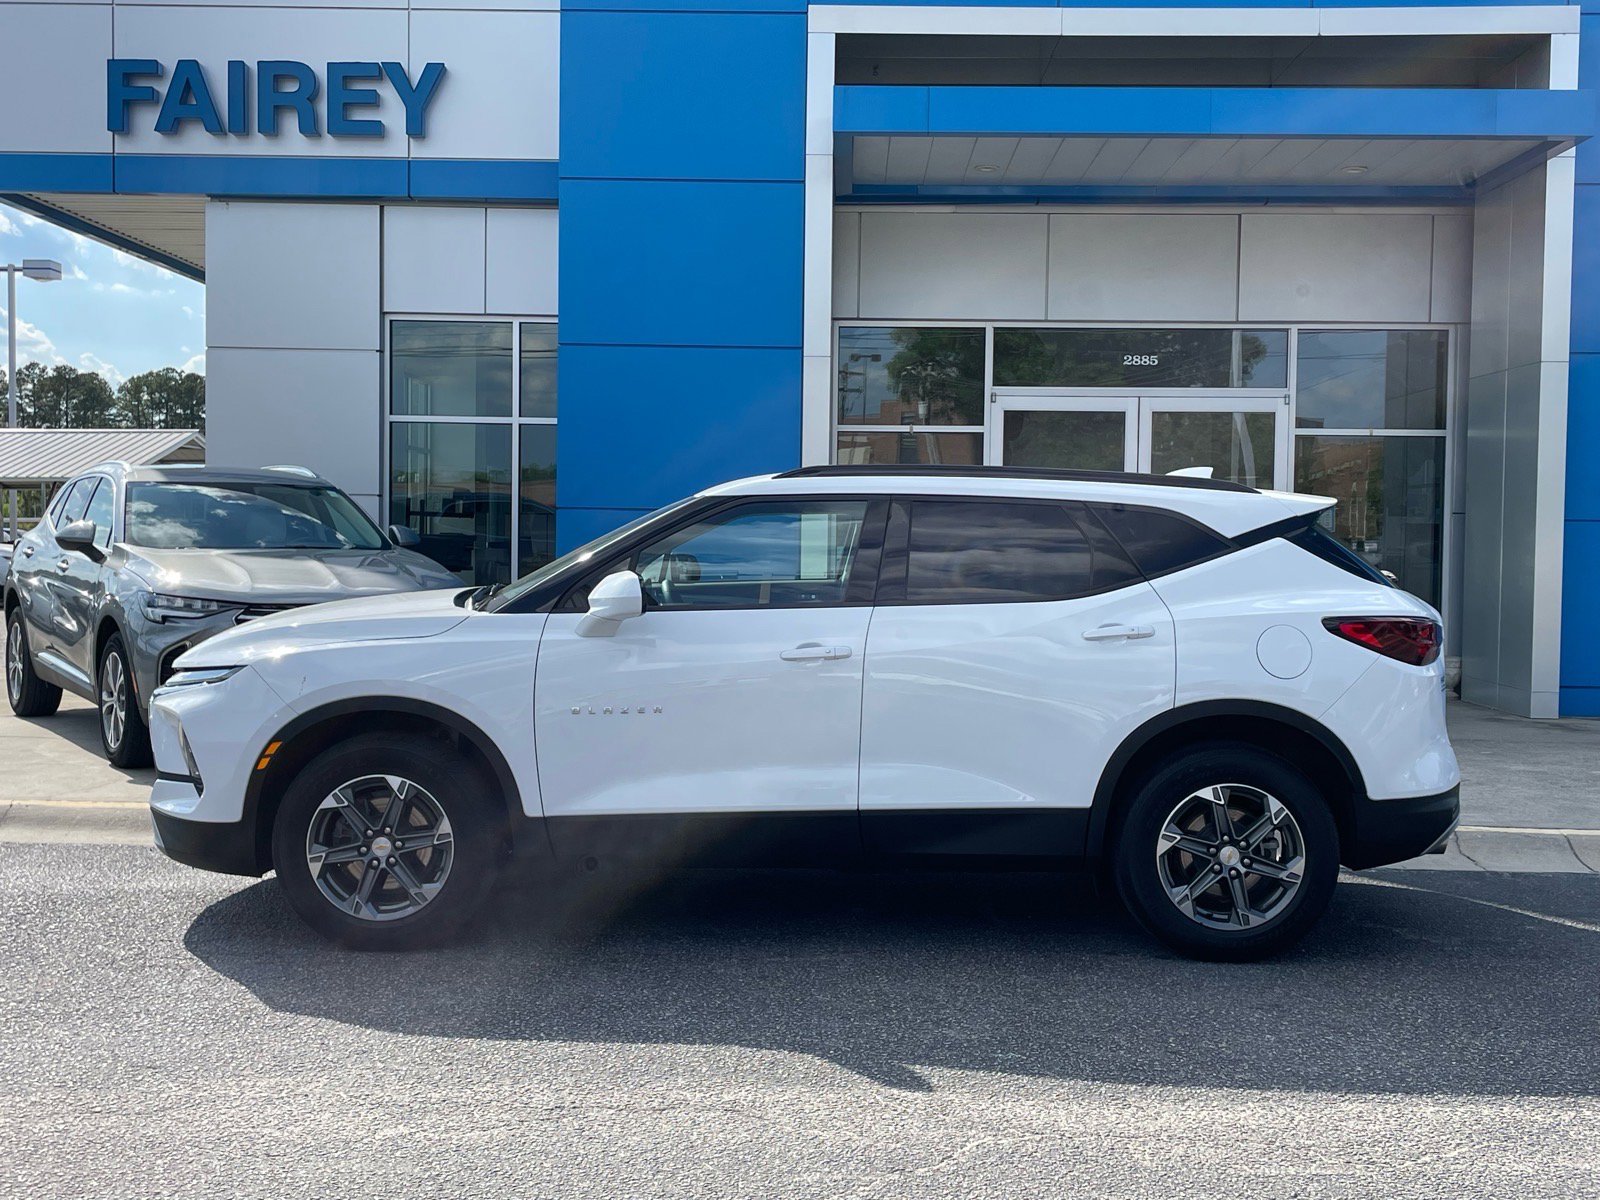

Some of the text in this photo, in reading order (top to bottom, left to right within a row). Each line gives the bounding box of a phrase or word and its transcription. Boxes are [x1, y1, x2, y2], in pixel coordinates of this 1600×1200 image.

[107, 59, 447, 138] FAIREY
[1122, 354, 1159, 366] 2885
[571, 705, 663, 715] BLAZER
